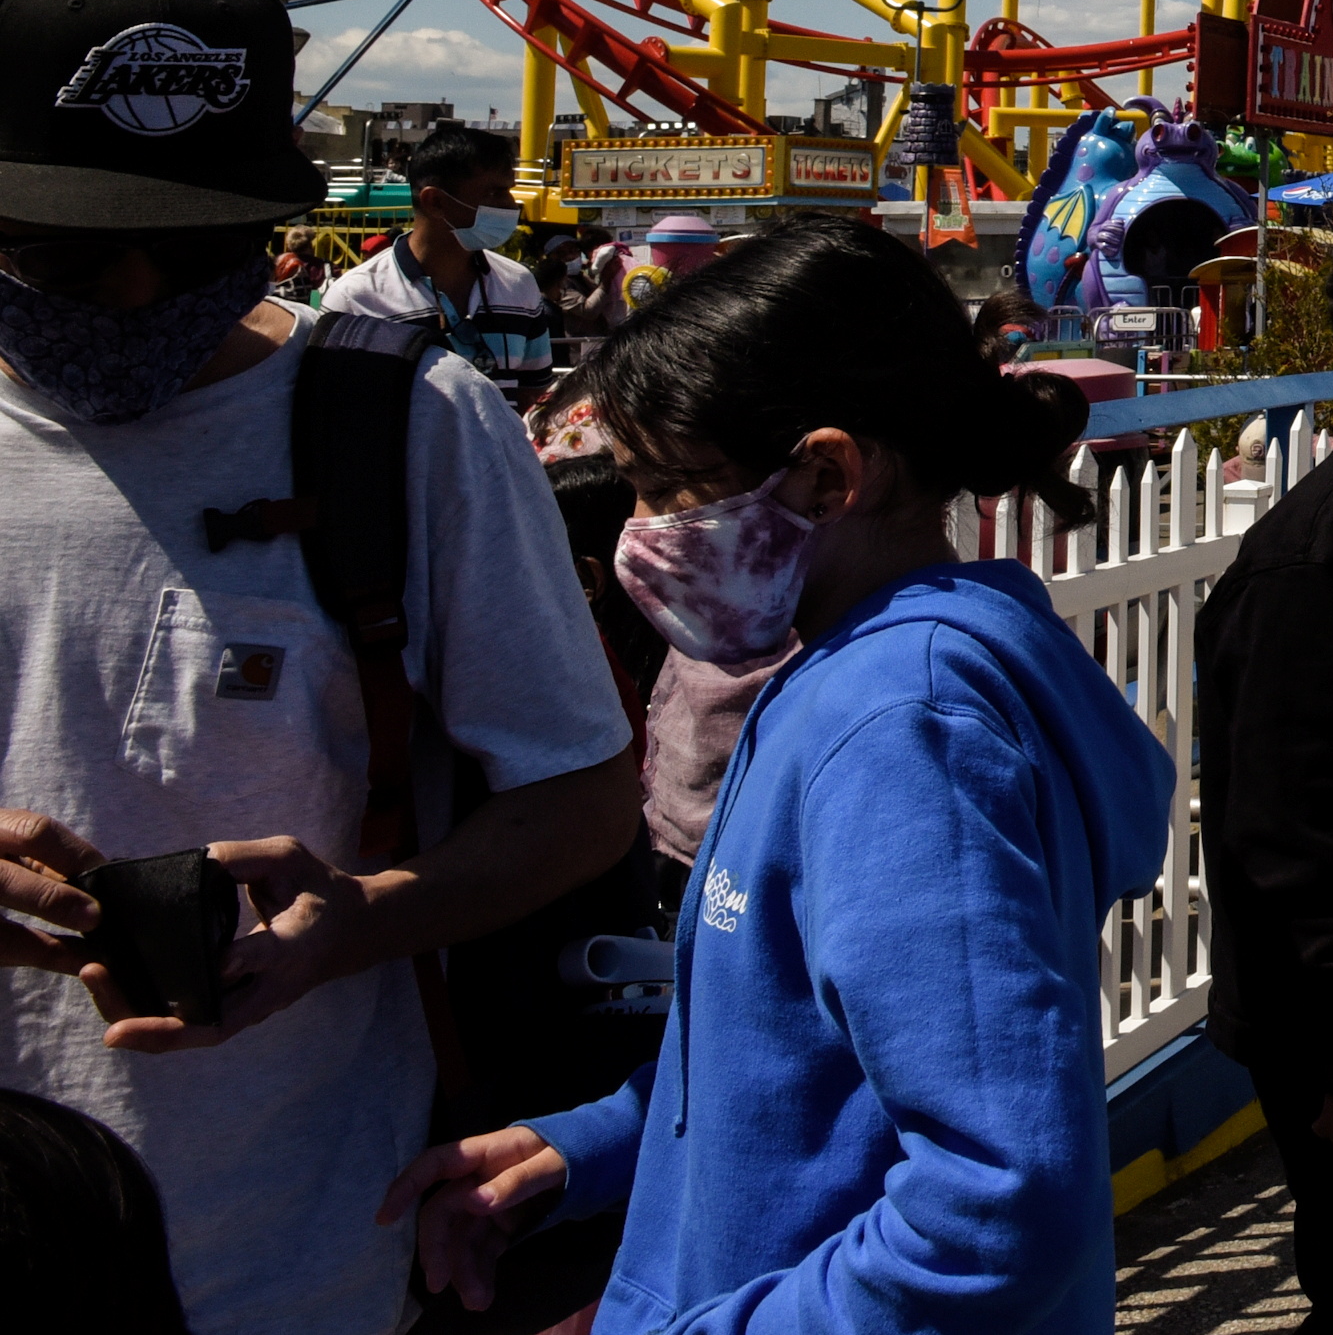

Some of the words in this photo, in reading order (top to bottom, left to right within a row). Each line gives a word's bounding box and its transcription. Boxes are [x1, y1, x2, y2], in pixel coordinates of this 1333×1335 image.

[128, 52, 164, 62] LOS
[165, 52, 243, 63] ANGELES
[61, 50, 249, 109] LAKERS
[584, 152, 751, 182] TICKETS
[794, 153, 869, 182] TICKETS
[1122, 314, 1147, 324] Enter
